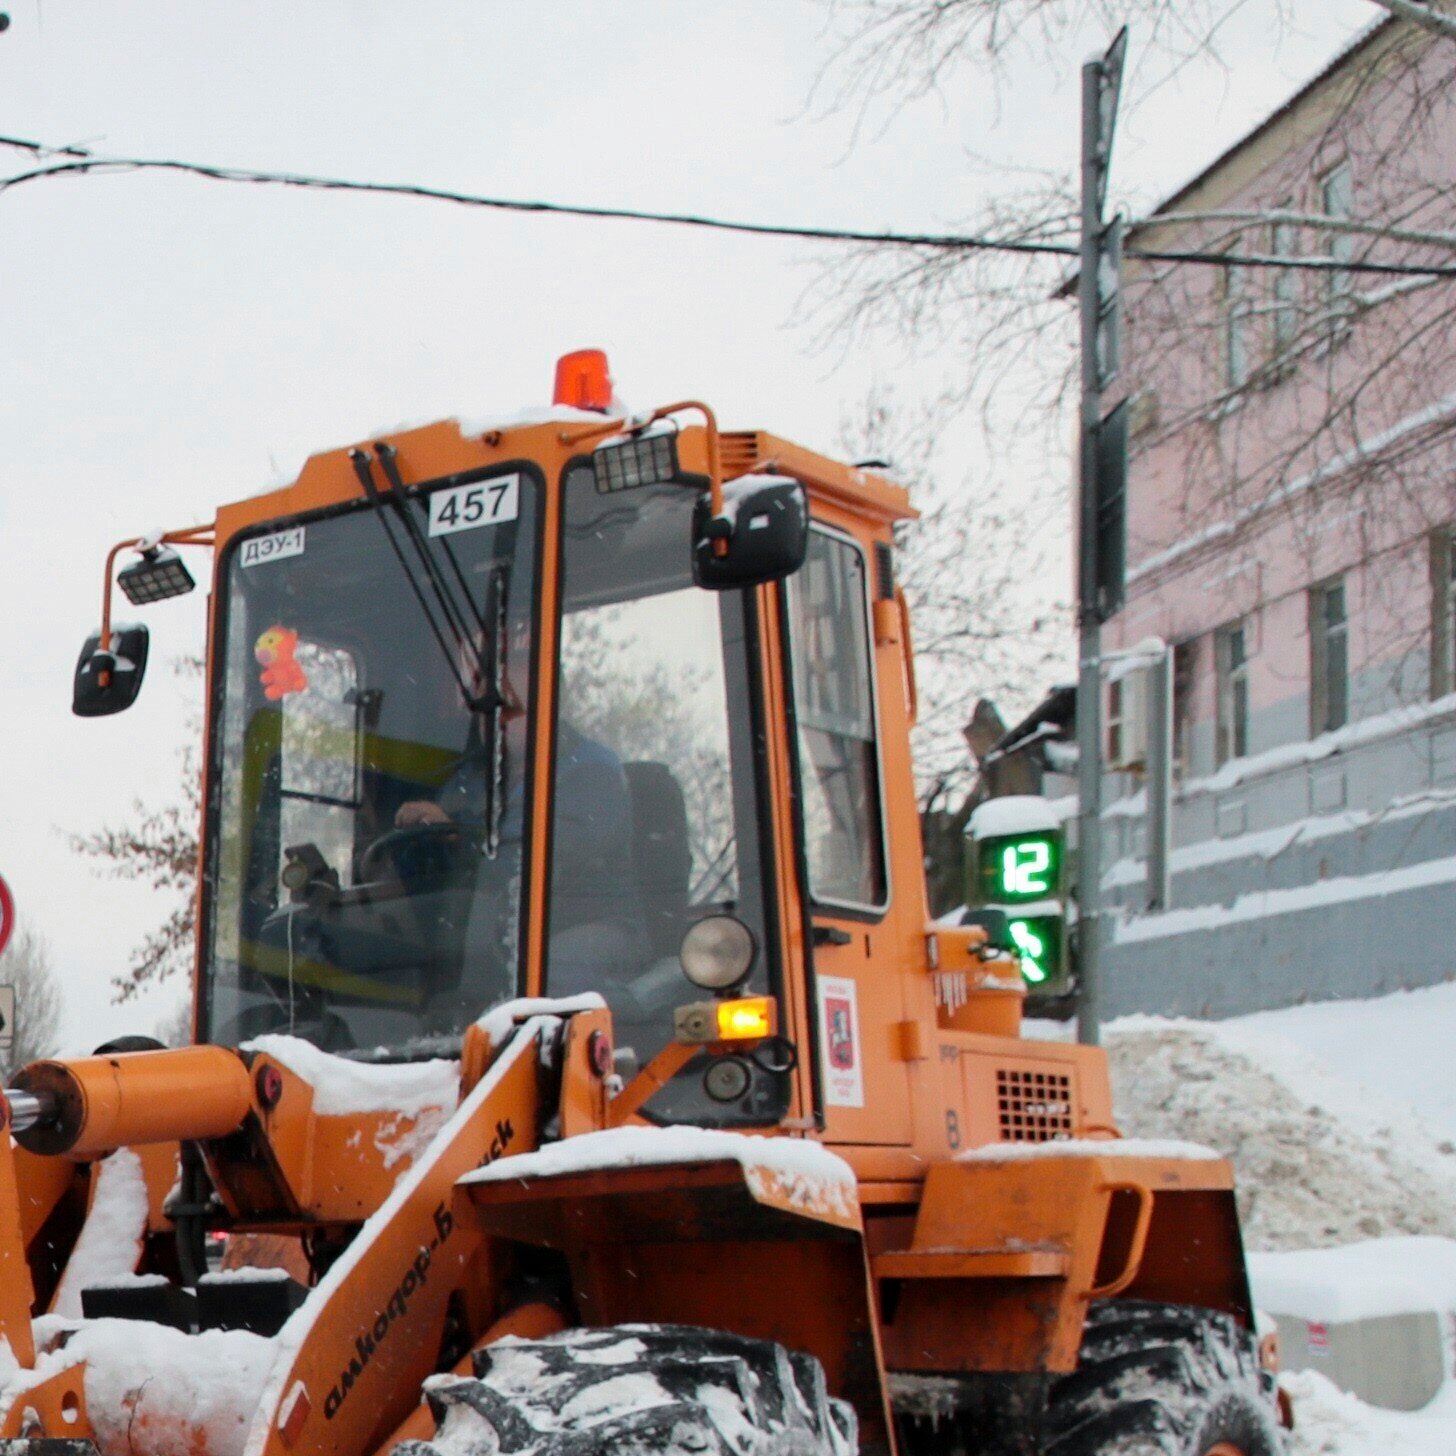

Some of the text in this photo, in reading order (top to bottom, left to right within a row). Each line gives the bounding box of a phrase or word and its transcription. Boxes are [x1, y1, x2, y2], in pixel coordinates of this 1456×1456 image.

[436, 483, 510, 528] 457
[244, 535, 302, 563] ДЭУ-1
[1003, 841, 1049, 893] 12
